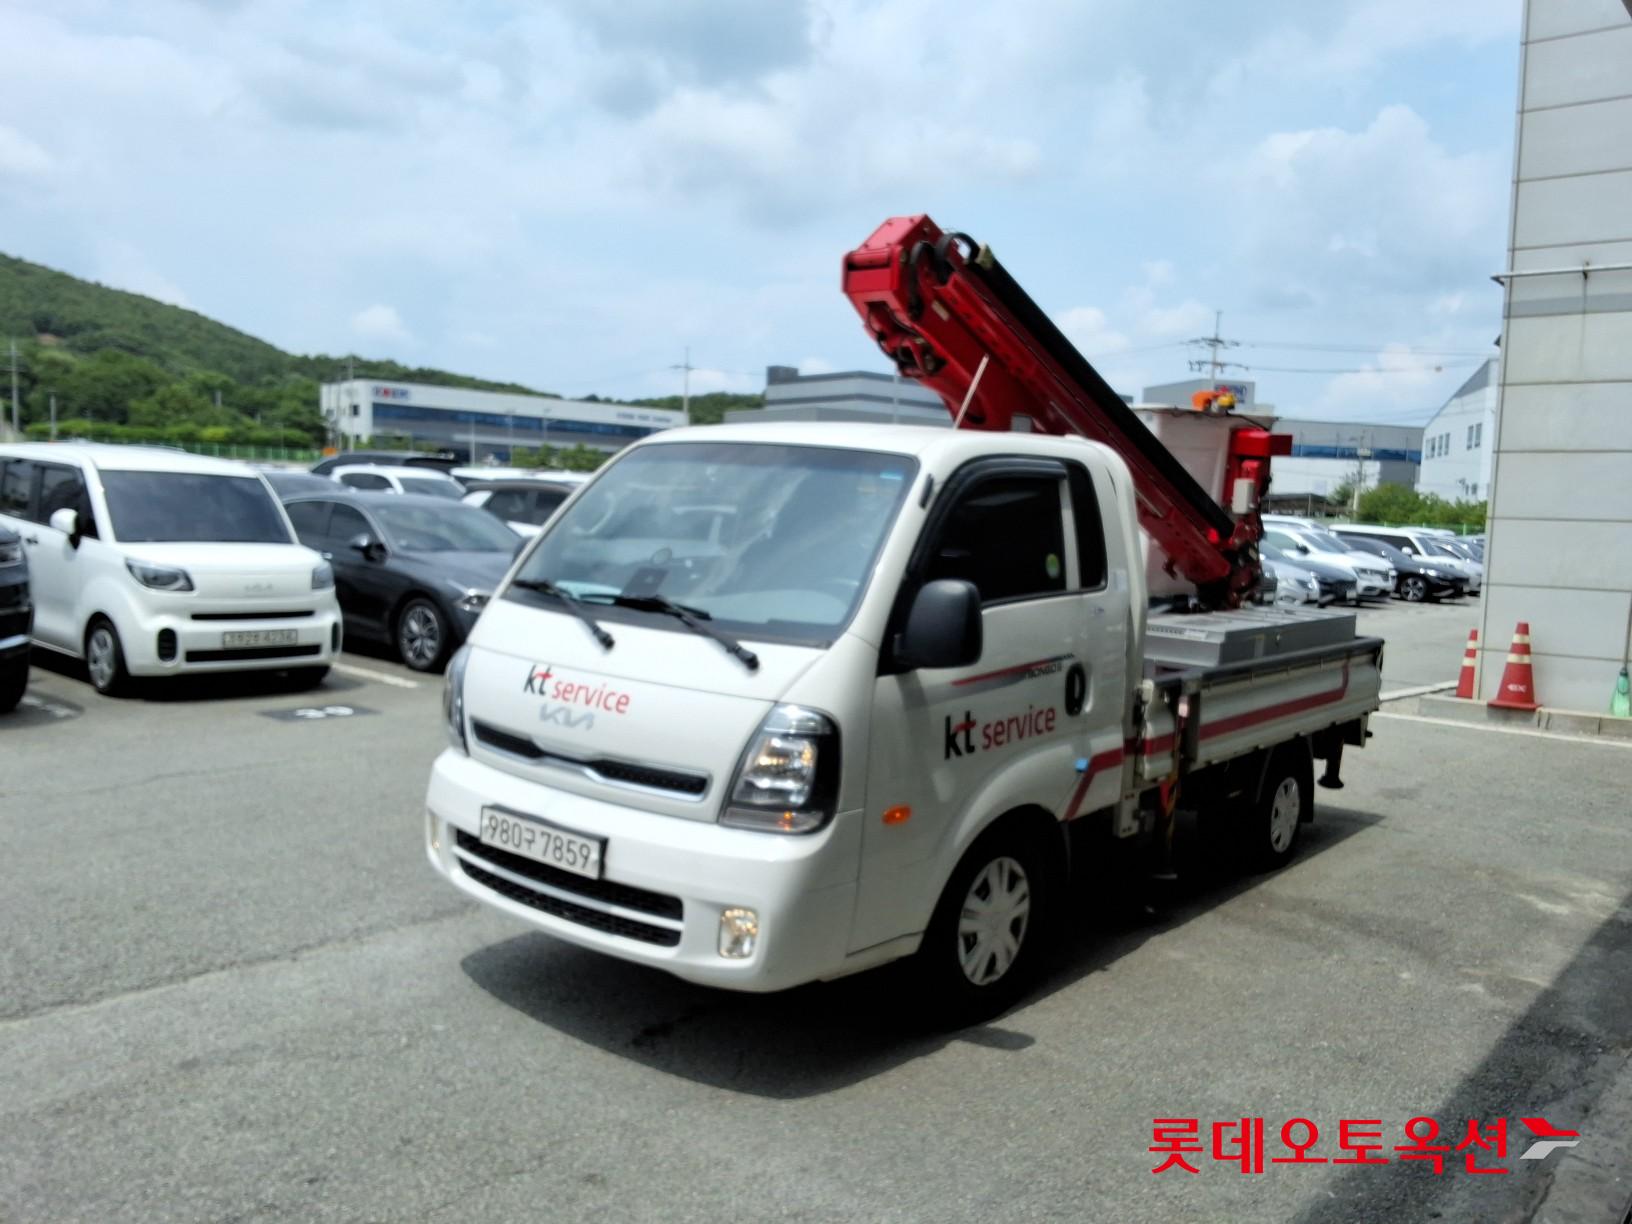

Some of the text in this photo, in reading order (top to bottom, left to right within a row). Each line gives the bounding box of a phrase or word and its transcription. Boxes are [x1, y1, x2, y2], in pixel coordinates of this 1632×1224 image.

[524, 665, 630, 713] kt service
[944, 704, 1056, 760] kt service
